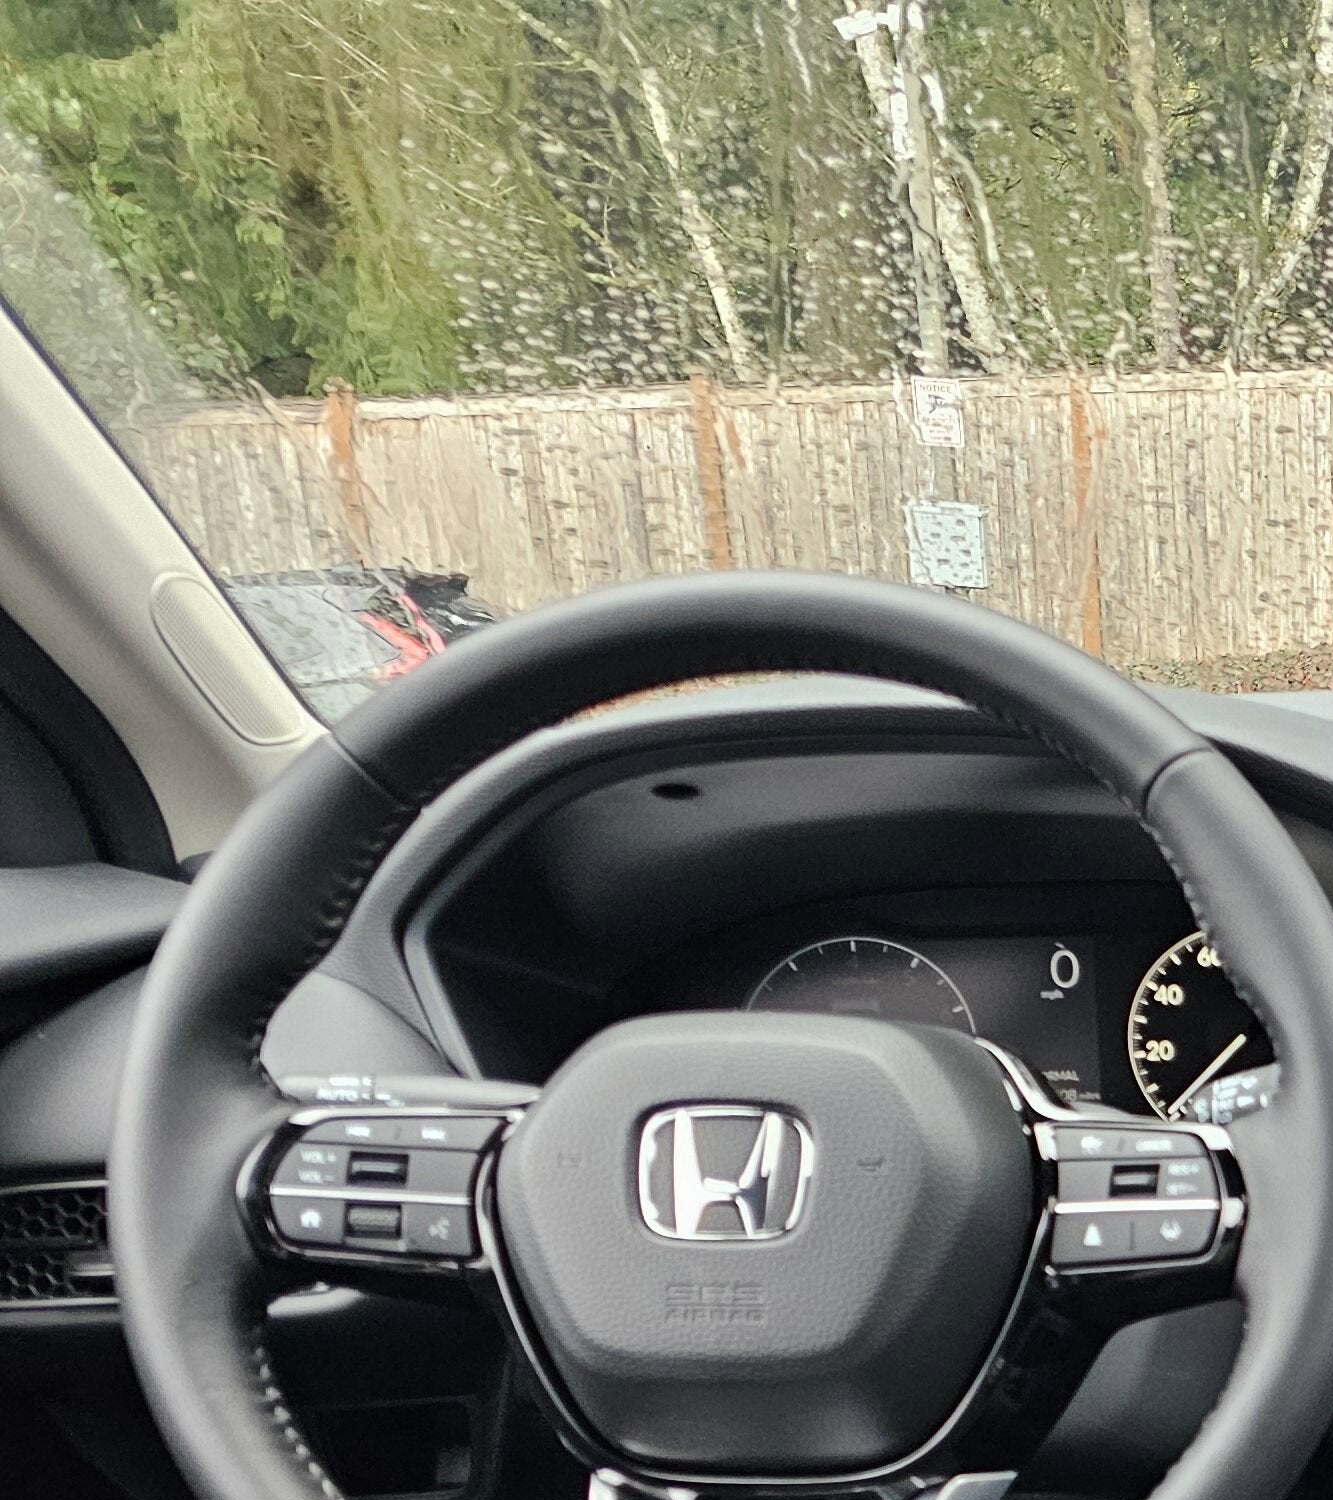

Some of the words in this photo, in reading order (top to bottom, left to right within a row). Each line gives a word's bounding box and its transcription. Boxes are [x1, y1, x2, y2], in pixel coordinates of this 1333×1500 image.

[919, 384, 952, 393] NOTICE
[1153, 984, 1184, 1005] 40
[1146, 1040, 1175, 1061] 20
